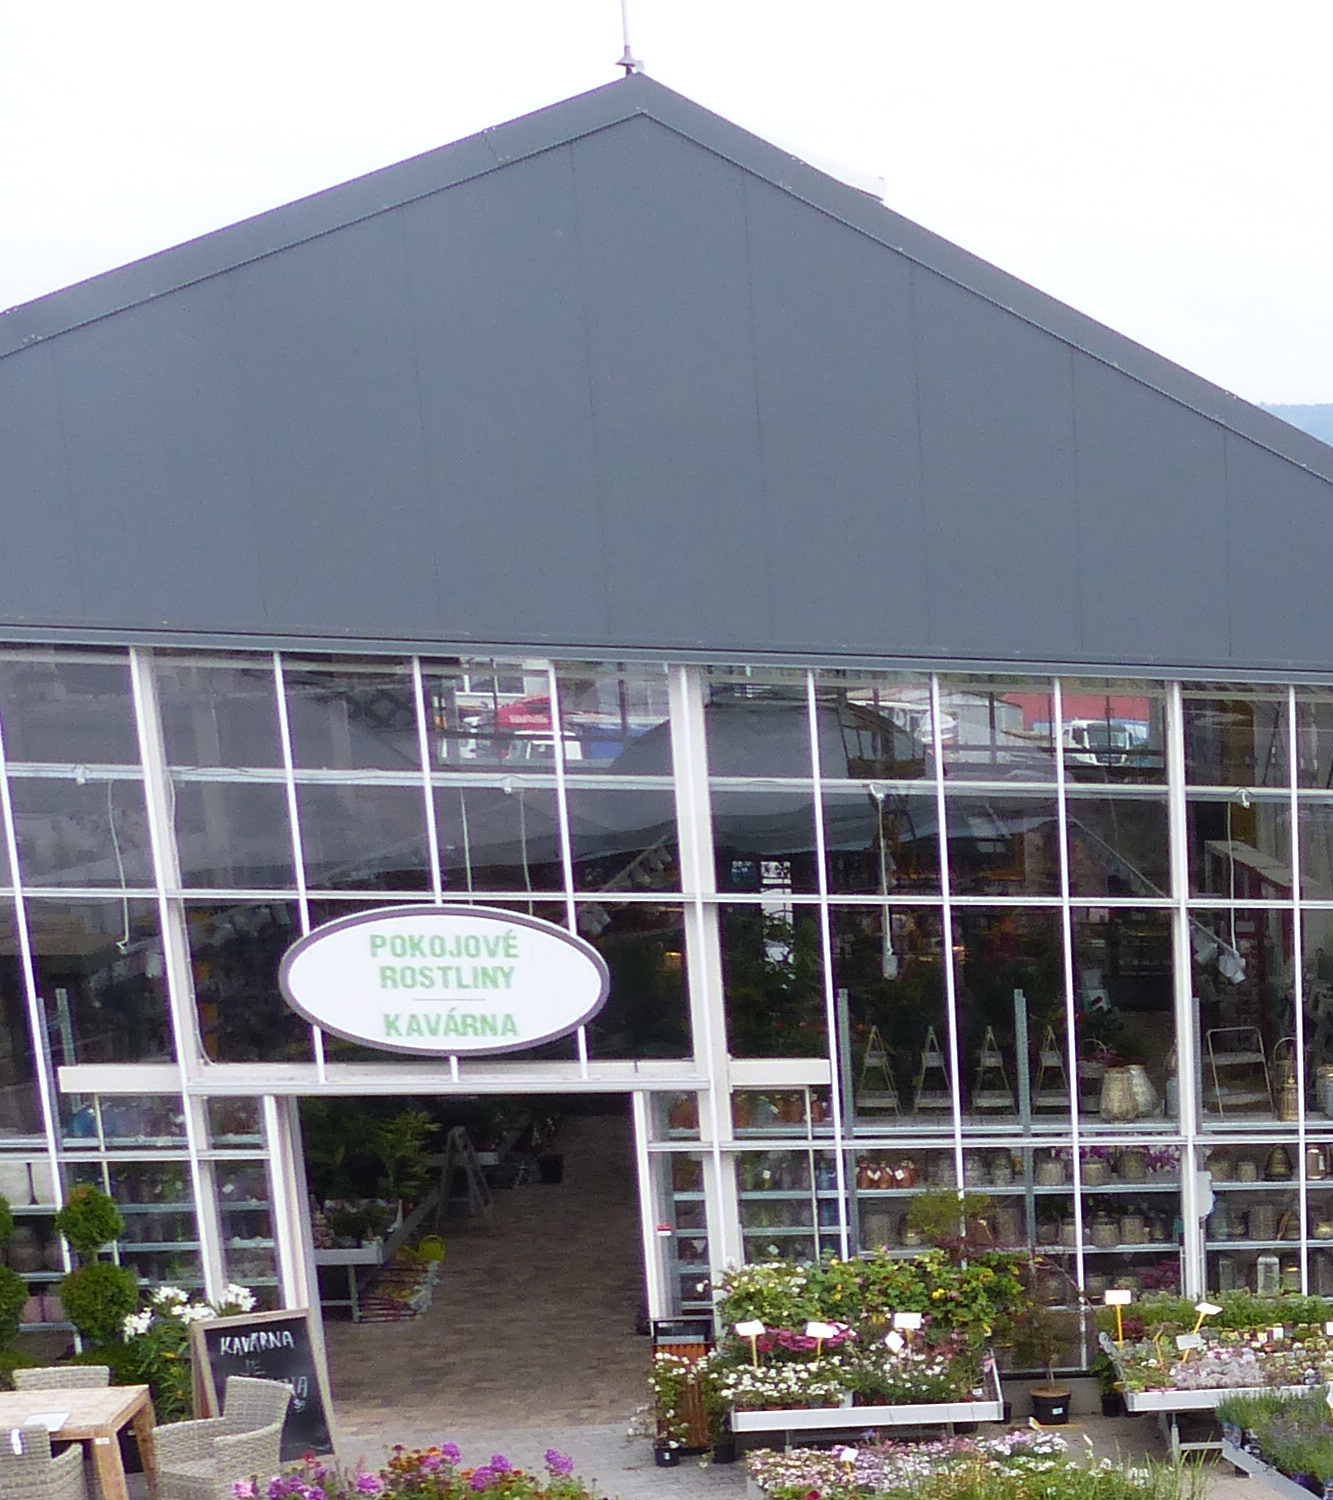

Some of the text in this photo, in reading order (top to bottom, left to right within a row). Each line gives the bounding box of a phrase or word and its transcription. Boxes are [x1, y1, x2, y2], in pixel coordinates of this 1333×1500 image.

[369, 929, 519, 958] POKOJOVÉ
[379, 965, 515, 989] ROSTLINY
[383, 1007, 520, 1037] KAVÁRNA
